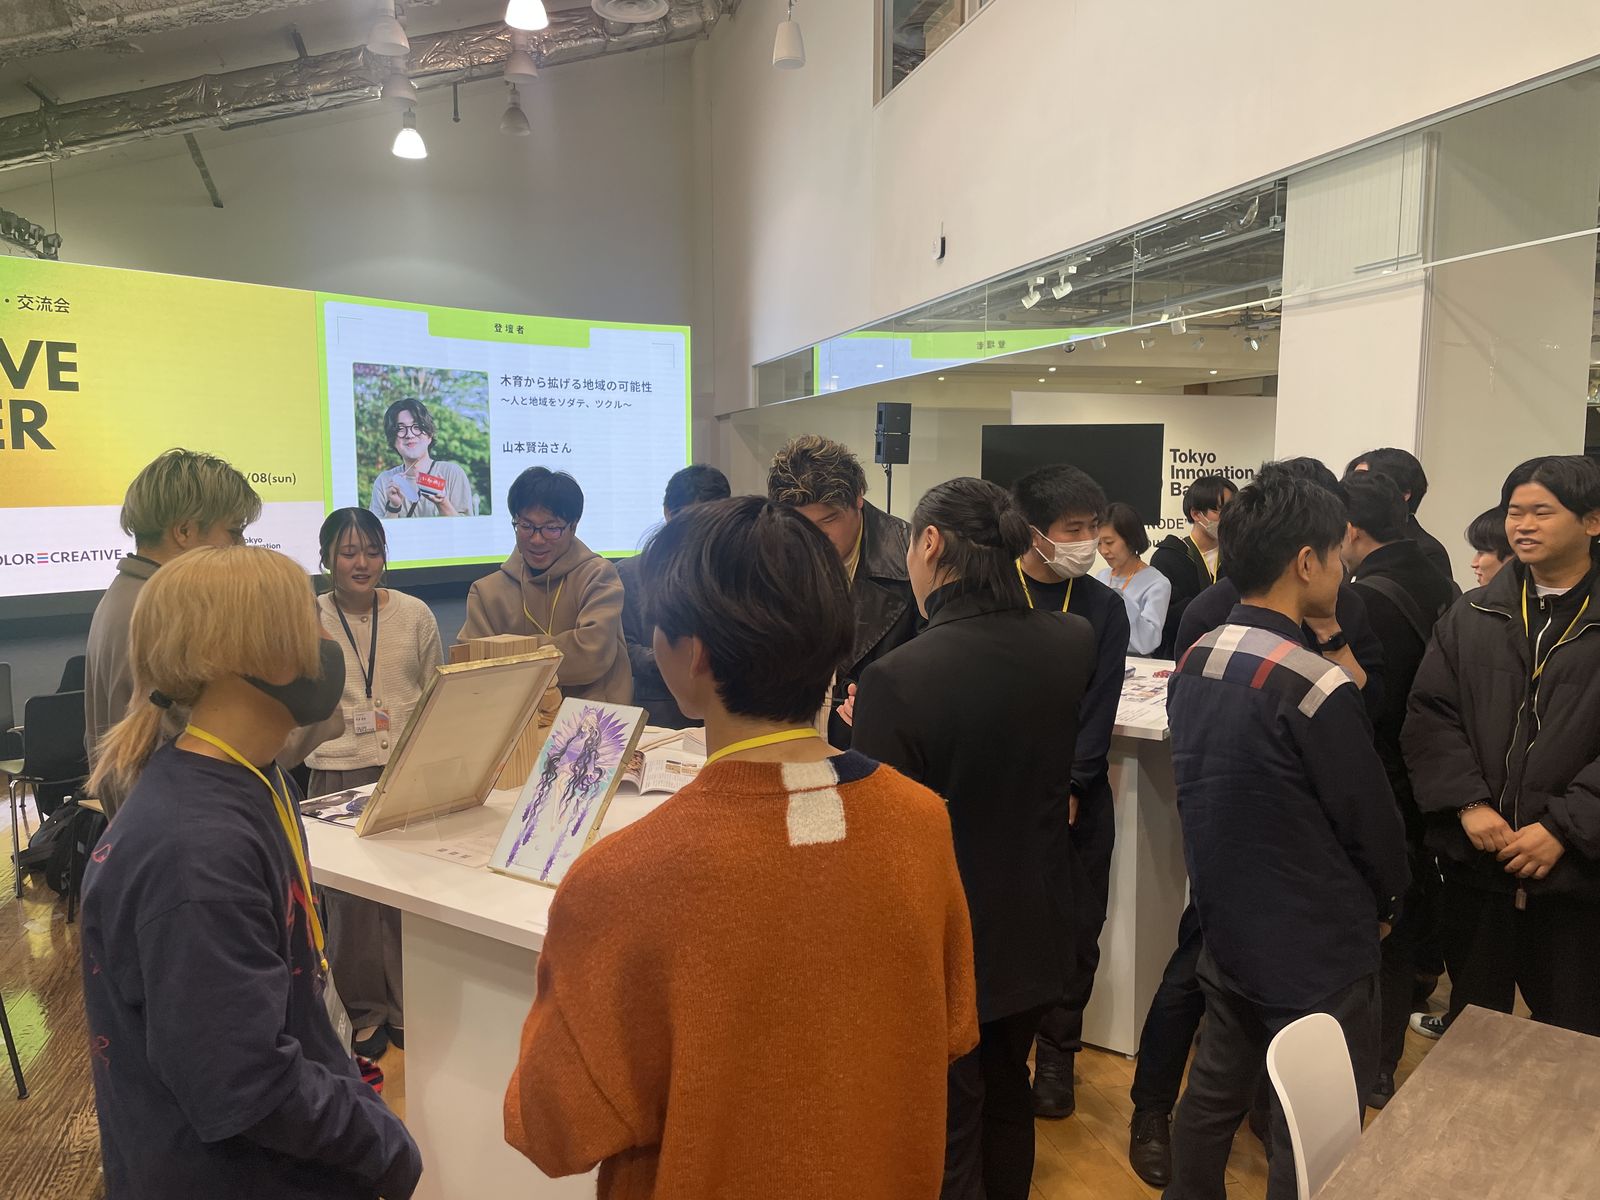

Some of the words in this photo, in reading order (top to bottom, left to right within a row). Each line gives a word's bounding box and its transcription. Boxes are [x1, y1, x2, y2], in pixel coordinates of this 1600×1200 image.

[494, 322, 525, 335] 登壇者
[500, 374, 653, 393] 木育から拡げる地域の可能性
[502, 441, 572, 454] 山本賢治さん
[1170, 449, 1216, 466] Tokyo
[1171, 465, 1254, 479] Innovation
[1170, 482, 1190, 496] Ba
